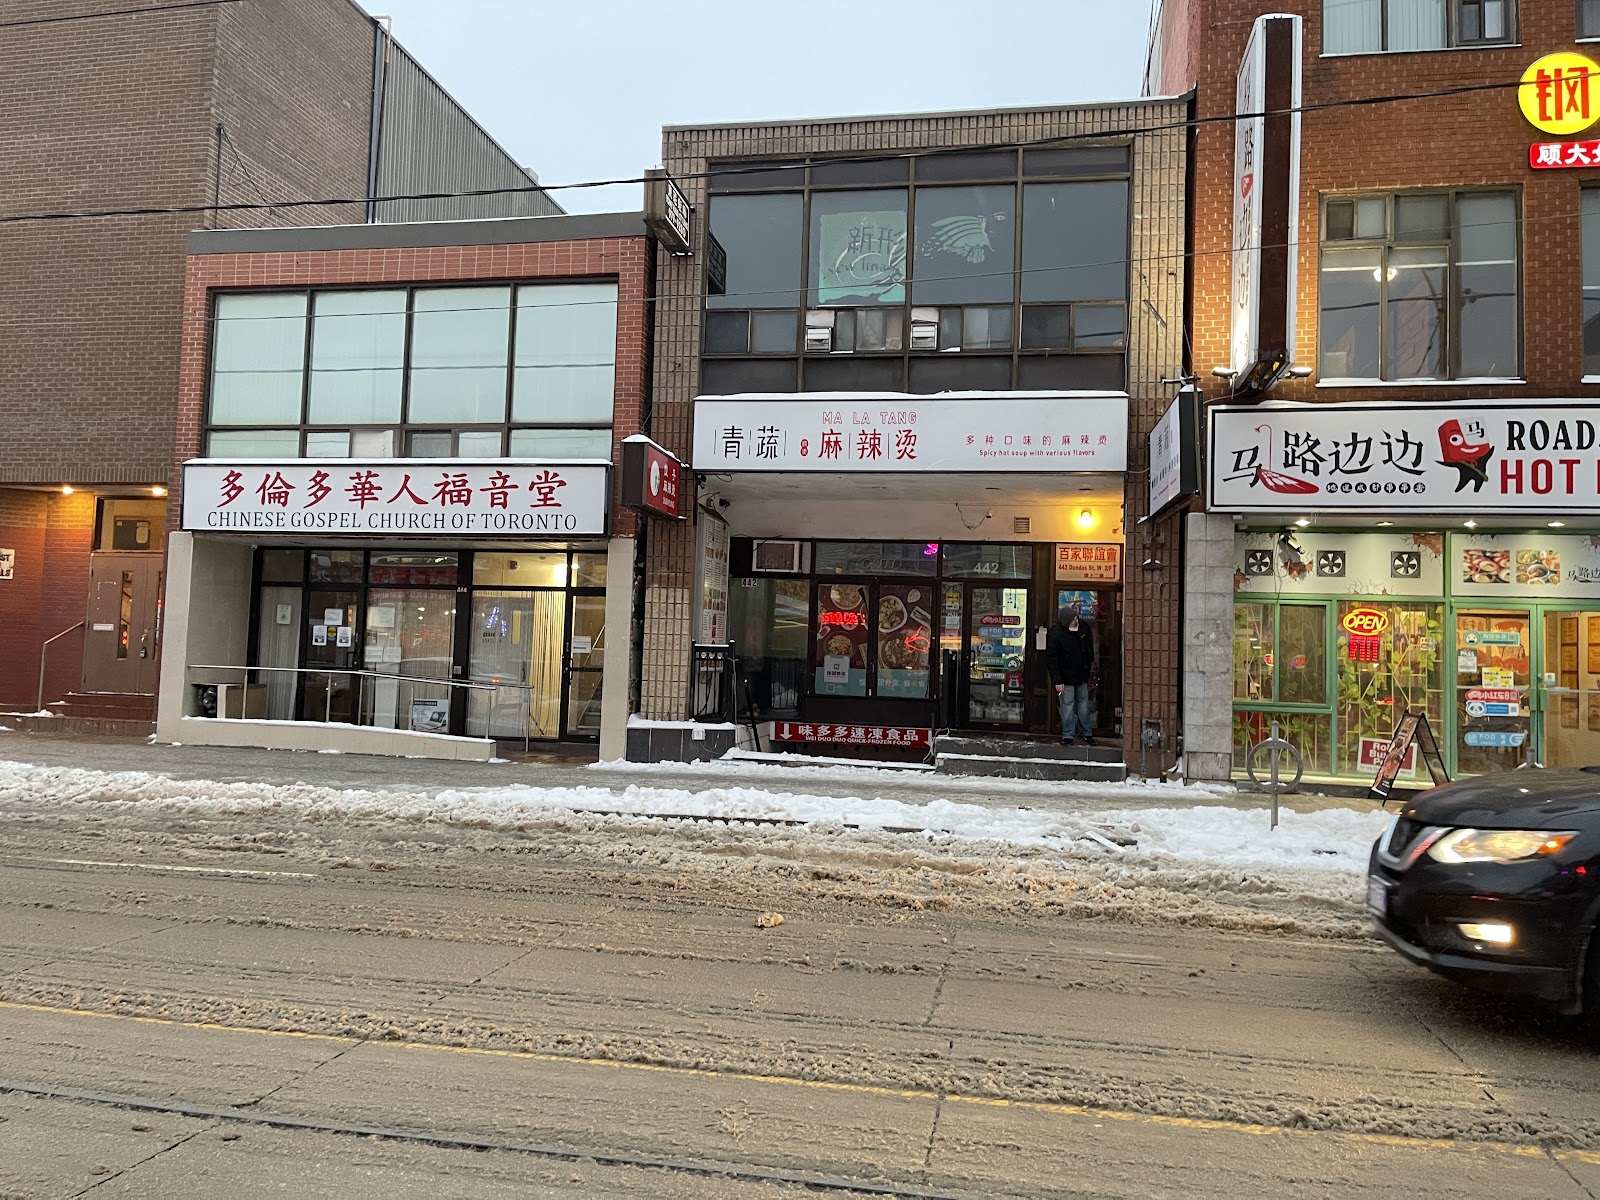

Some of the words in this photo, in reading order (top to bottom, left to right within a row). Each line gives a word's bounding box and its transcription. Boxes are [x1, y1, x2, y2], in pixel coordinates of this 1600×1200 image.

[822, 411, 843, 425] MA
[852, 411, 870, 425] LA
[880, 411, 918, 425] TANG
[721, 425, 780, 460] 青蔬
[818, 428, 918, 460] 麻辣烫
[1506, 420, 1600, 451] ROAD
[979, 449, 997, 457] Spicy
[1222, 429, 1428, 488] 马路边边
[1500, 458, 1581, 495] HOT
[216, 469, 567, 510] 多倫多華人福音堂
[207, 511, 286, 528] CHINESE
[291, 512, 362, 528] GOSPEL
[368, 513, 446, 529] CHURCH
[451, 513, 476, 529] OF
[481, 513, 577, 530] TORONTO
[973, 562, 1000, 575] 442
[742, 578, 757, 587] 442
[1345, 615, 1385, 630] OPEN
[798, 725, 918, 741] 味多多速凍食品
